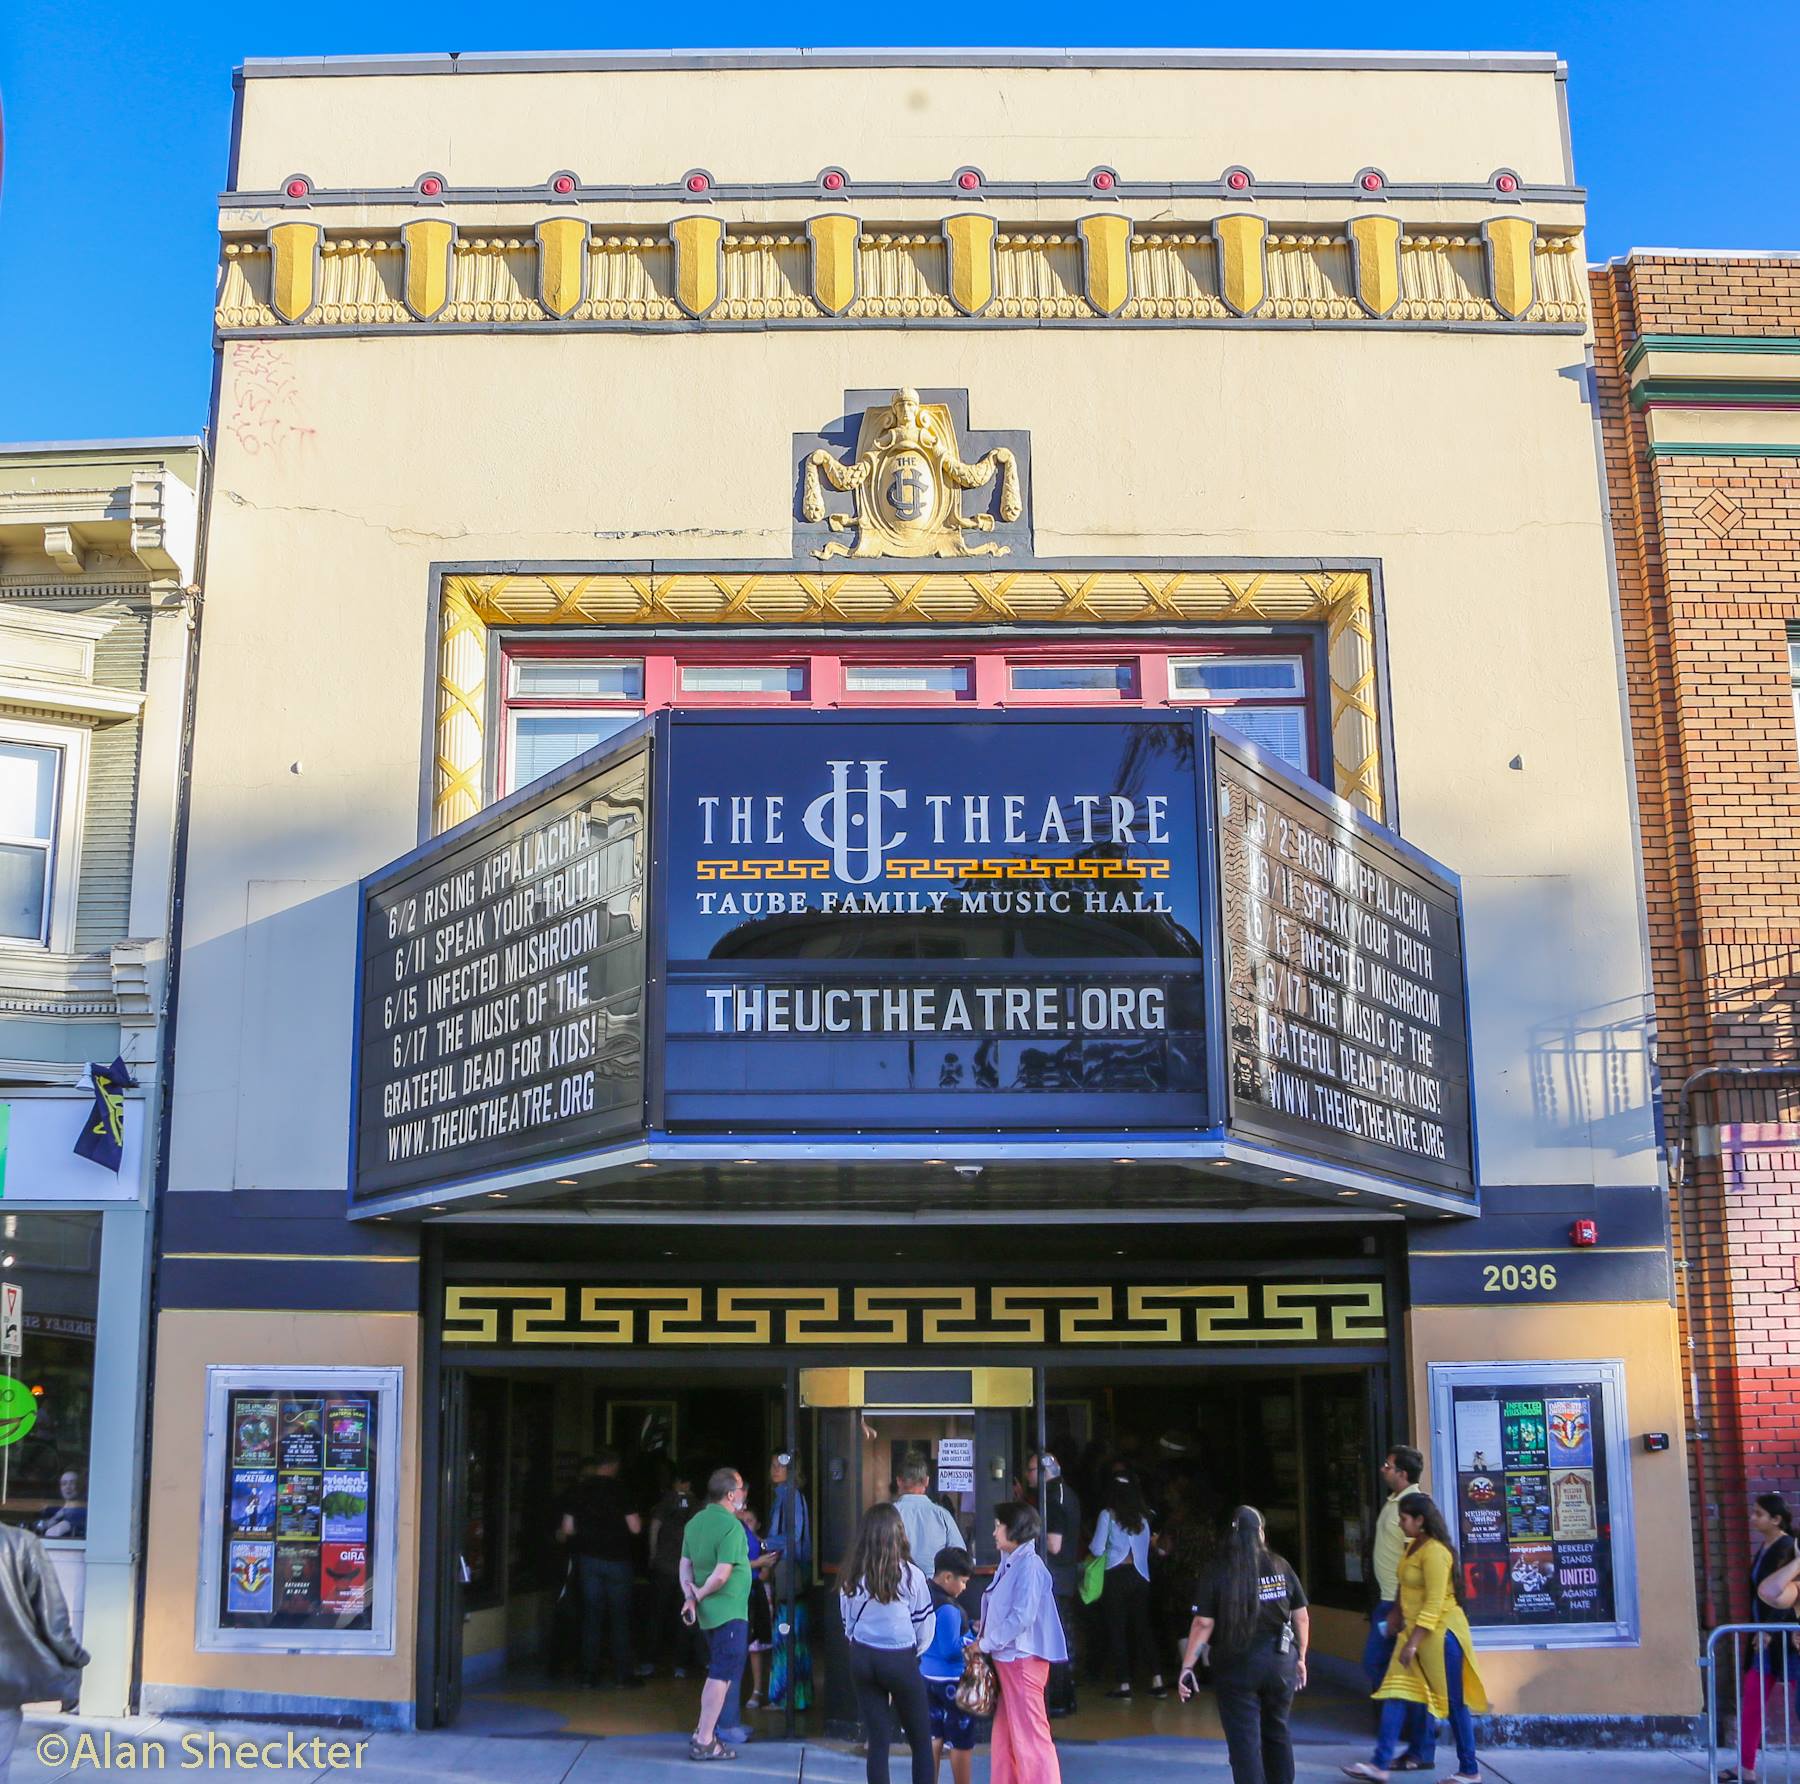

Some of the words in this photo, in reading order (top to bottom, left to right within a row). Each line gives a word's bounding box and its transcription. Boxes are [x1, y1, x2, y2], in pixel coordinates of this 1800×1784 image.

[896, 456, 917, 467] THE
[698, 796, 785, 845] THE
[925, 795, 1170, 845] THEATRE
[388, 898, 417, 940] 6/2
[424, 870, 475, 925] RISING
[481, 813, 591, 899] APPALACHIA
[1257, 801, 1290, 858] 6/2
[1350, 855, 1431, 938] APPALACHIA
[395, 937, 426, 982] 6/11
[435, 911, 486, 965] SPEAK
[493, 888, 535, 941] YOUR
[542, 853, 599, 918] TRUTH
[697, 892, 808, 915] TAUBE
[820, 891, 949, 915] FAMILY
[959, 891, 1071, 914] MUSIC
[1079, 890, 1173, 914] HALL
[1260, 857, 1294, 910] 6/11
[1303, 881, 1349, 939] SPEAK
[1355, 908, 1390, 959] YOUR
[1394, 930, 1433, 980] TRUTH
[384, 986, 418, 1030] 6/15
[427, 953, 499, 1014] INFECTED
[504, 909, 598, 985] MUSHROOM
[1254, 904, 1290, 957] 6/15
[1370, 963, 1440, 1027] MUSHROOM
[393, 1026, 428, 1068] 6/17
[437, 1014, 464, 1056] THE
[471, 993, 520, 1046] MUSIC
[527, 982, 548, 1025] OF
[556, 966, 589, 1014] THE
[706, 986, 1166, 1032] THEUCTHEATRE.ORG
[1265, 962, 1300, 1013] 6/17
[1309, 983, 1337, 1029] THE
[1341, 996, 1385, 1048] MUSIC
[1389, 1017, 1405, 1056] OF
[1409, 1026, 1433, 1068] THE
[383, 1065, 457, 1118] GRATEFUL
[462, 1048, 505, 1096] DEAD
[511, 1035, 542, 1081] FOR
[549, 1015, 597, 1069] KIDS!
[1340, 1043, 1377, 1092] DEAD
[1380, 1060, 1406, 1102] FOR
[1408, 1069, 1441, 1115] KIDS!
[388, 1070, 595, 1161] WWW.THEUCTHEATRE.ORG
[1269, 1066, 1446, 1160] WWW.THEUCTHEATRE.ORG
[1482, 1264, 1557, 1292] 2036
[1506, 1401, 1542, 1409] INFECTED
[940, 1471, 973, 1479] ADMISSION
[340, 1551, 365, 1561] GIRA
[1558, 1543, 1594, 1552] BERKELEY
[1561, 1555, 1592, 1564] STANDS
[1560, 1568, 1597, 1586] UNITED
[1562, 1589, 1598, 1598] AGAINST
[1570, 1601, 1591, 1609] HATE
